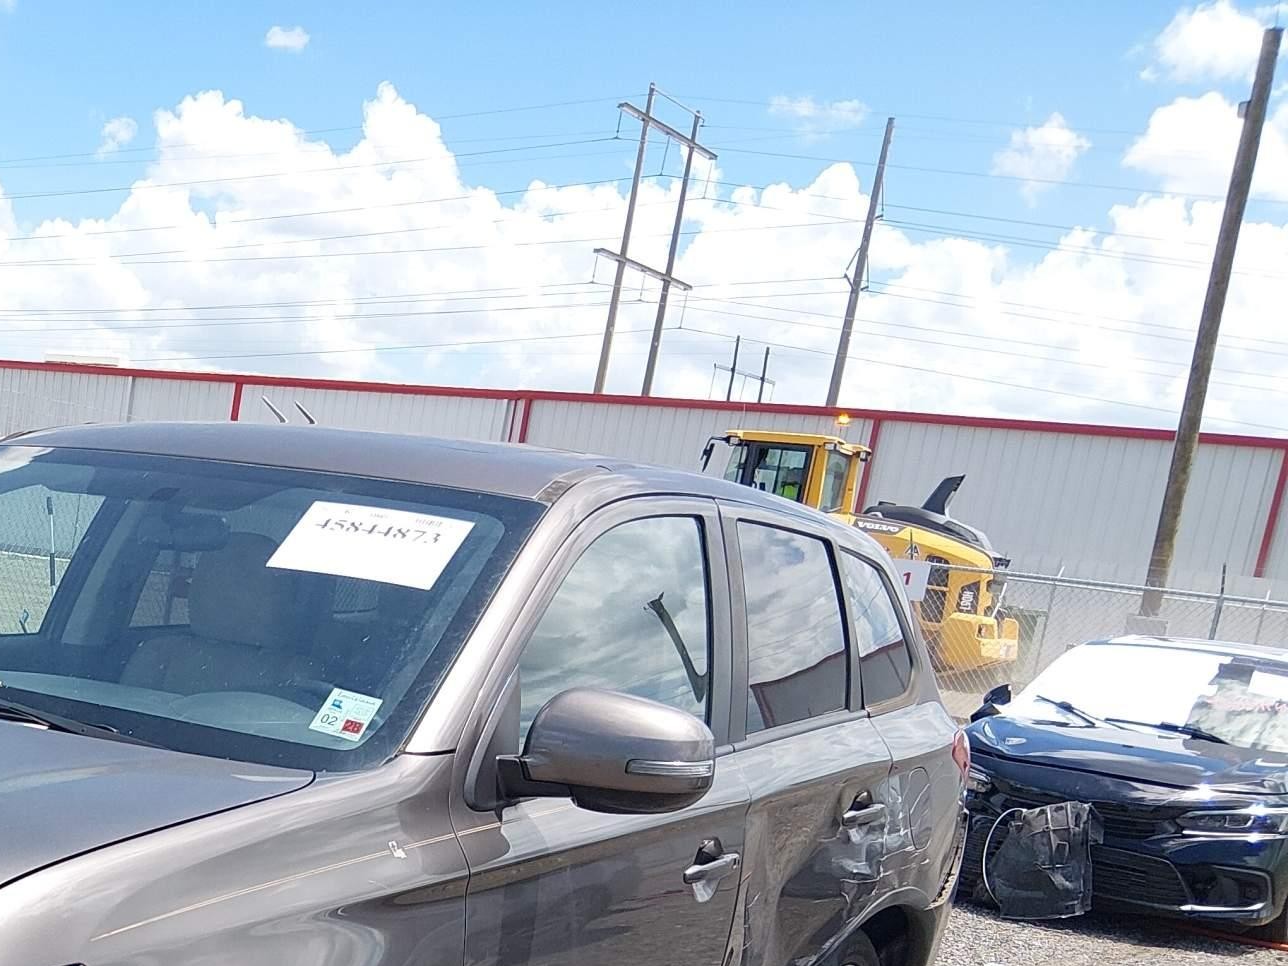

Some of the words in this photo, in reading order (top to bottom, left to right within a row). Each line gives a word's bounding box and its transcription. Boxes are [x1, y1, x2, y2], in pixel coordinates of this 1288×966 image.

[315, 517, 443, 545] 45844873
[857, 521, 900, 533] VOLVO
[320, 713, 338, 726] 02
